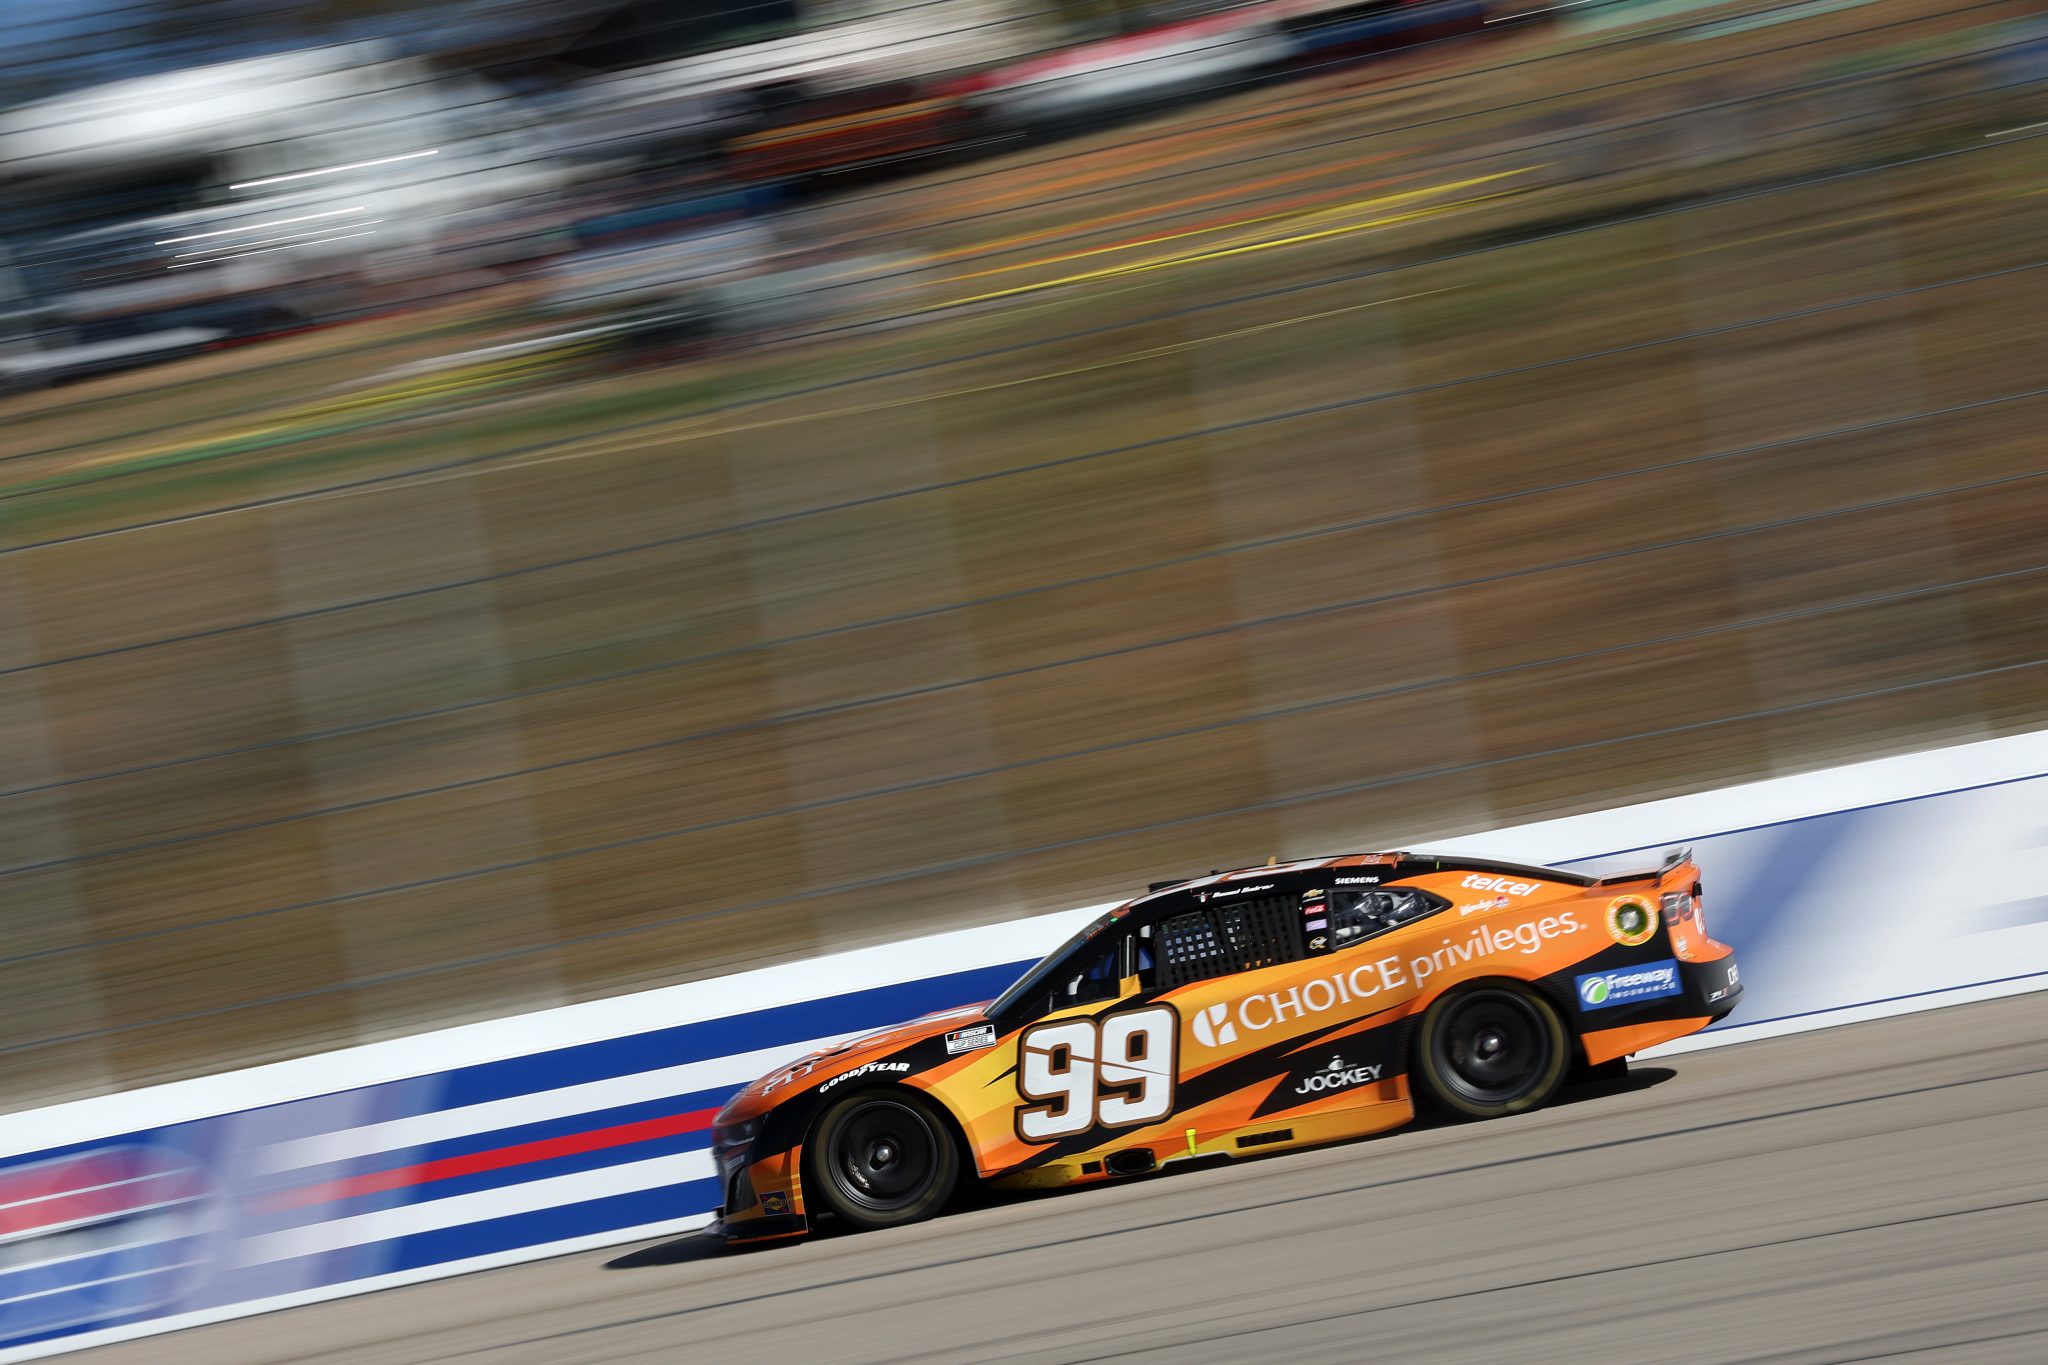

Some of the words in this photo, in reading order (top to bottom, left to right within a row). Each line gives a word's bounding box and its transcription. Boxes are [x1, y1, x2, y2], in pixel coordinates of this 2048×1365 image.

[1334, 876, 1380, 885] SIEMENS
[1461, 874, 1542, 896] telcel
[1238, 955, 1408, 1031] CHOICE
[1605, 967, 1674, 990] Freeway
[819, 1061, 911, 1094] GOODYEAR
[1017, 1004, 1179, 1143] 99
[1294, 1063, 1383, 1094] JOCKEY
